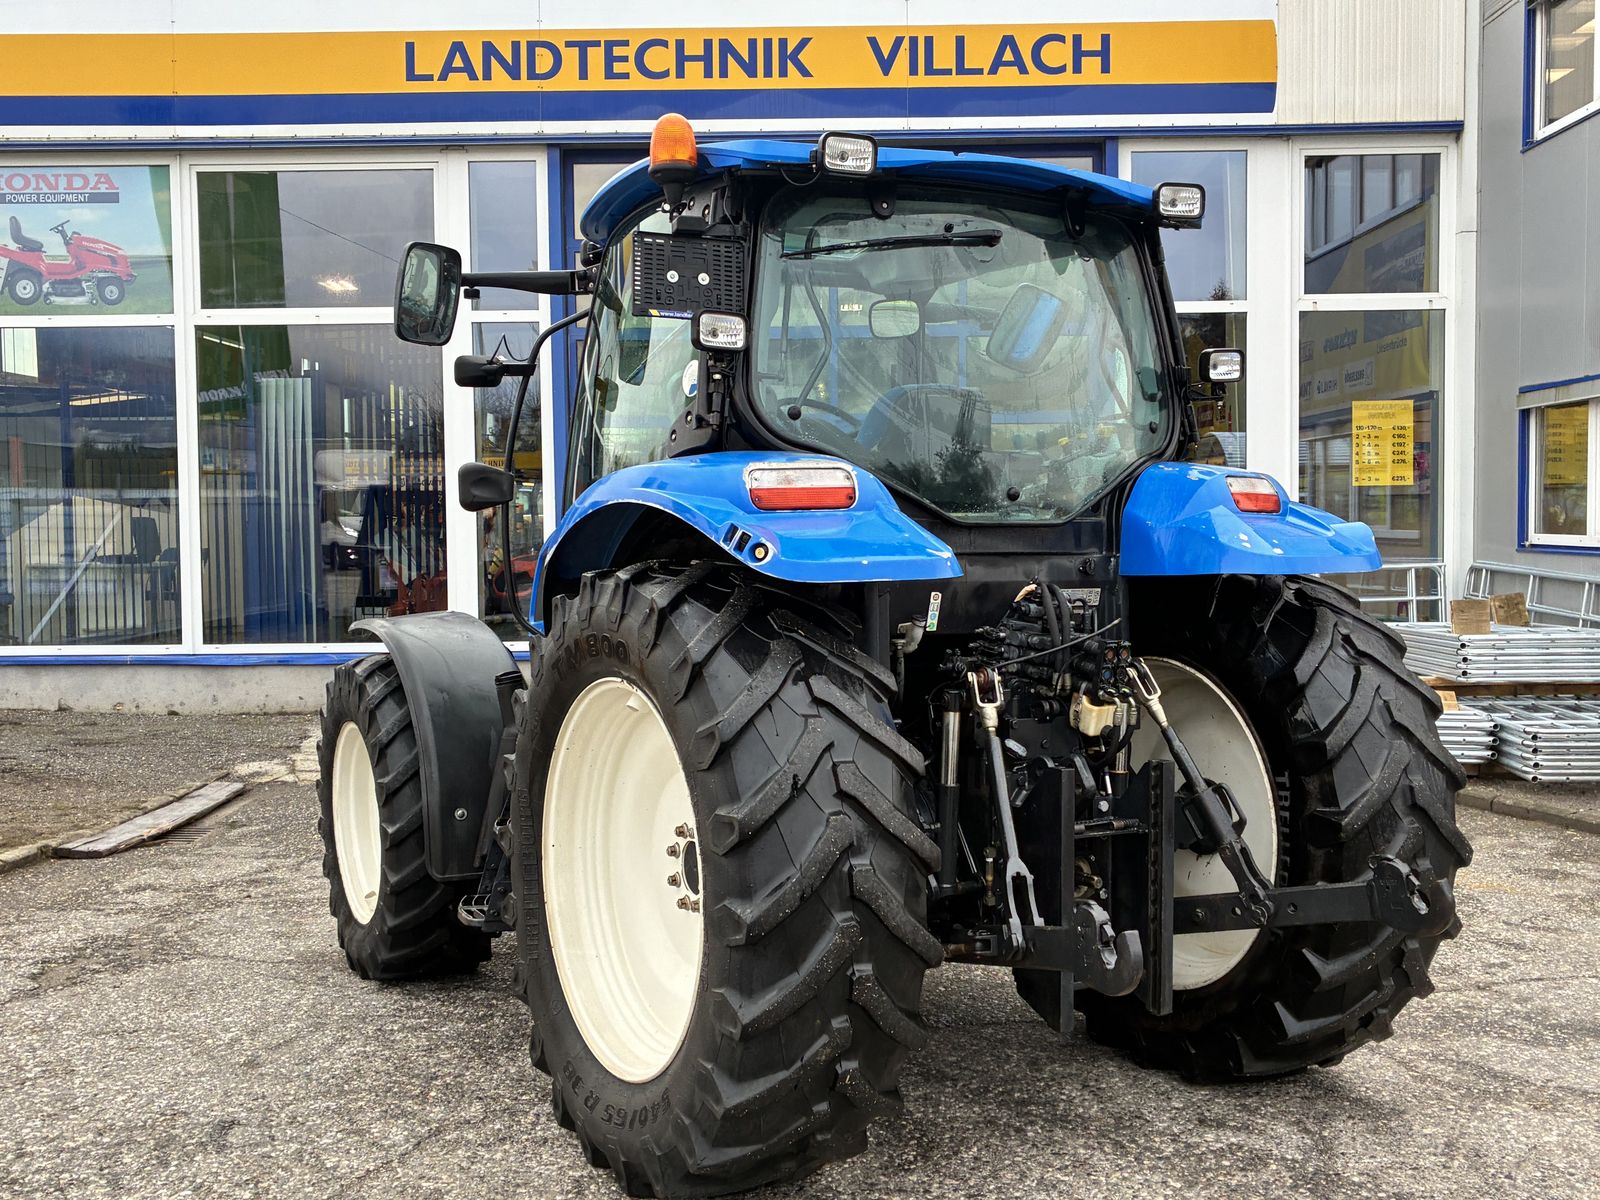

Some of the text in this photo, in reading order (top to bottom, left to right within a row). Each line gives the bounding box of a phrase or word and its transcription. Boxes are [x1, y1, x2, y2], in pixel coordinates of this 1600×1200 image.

[404, 33, 1111, 82] LANDTECHNIK VILLACH
[0, 173, 119, 191] ONDA
[5, 193, 90, 203] POWER EQUIPMENT
[583, 1089, 601, 1115] R
